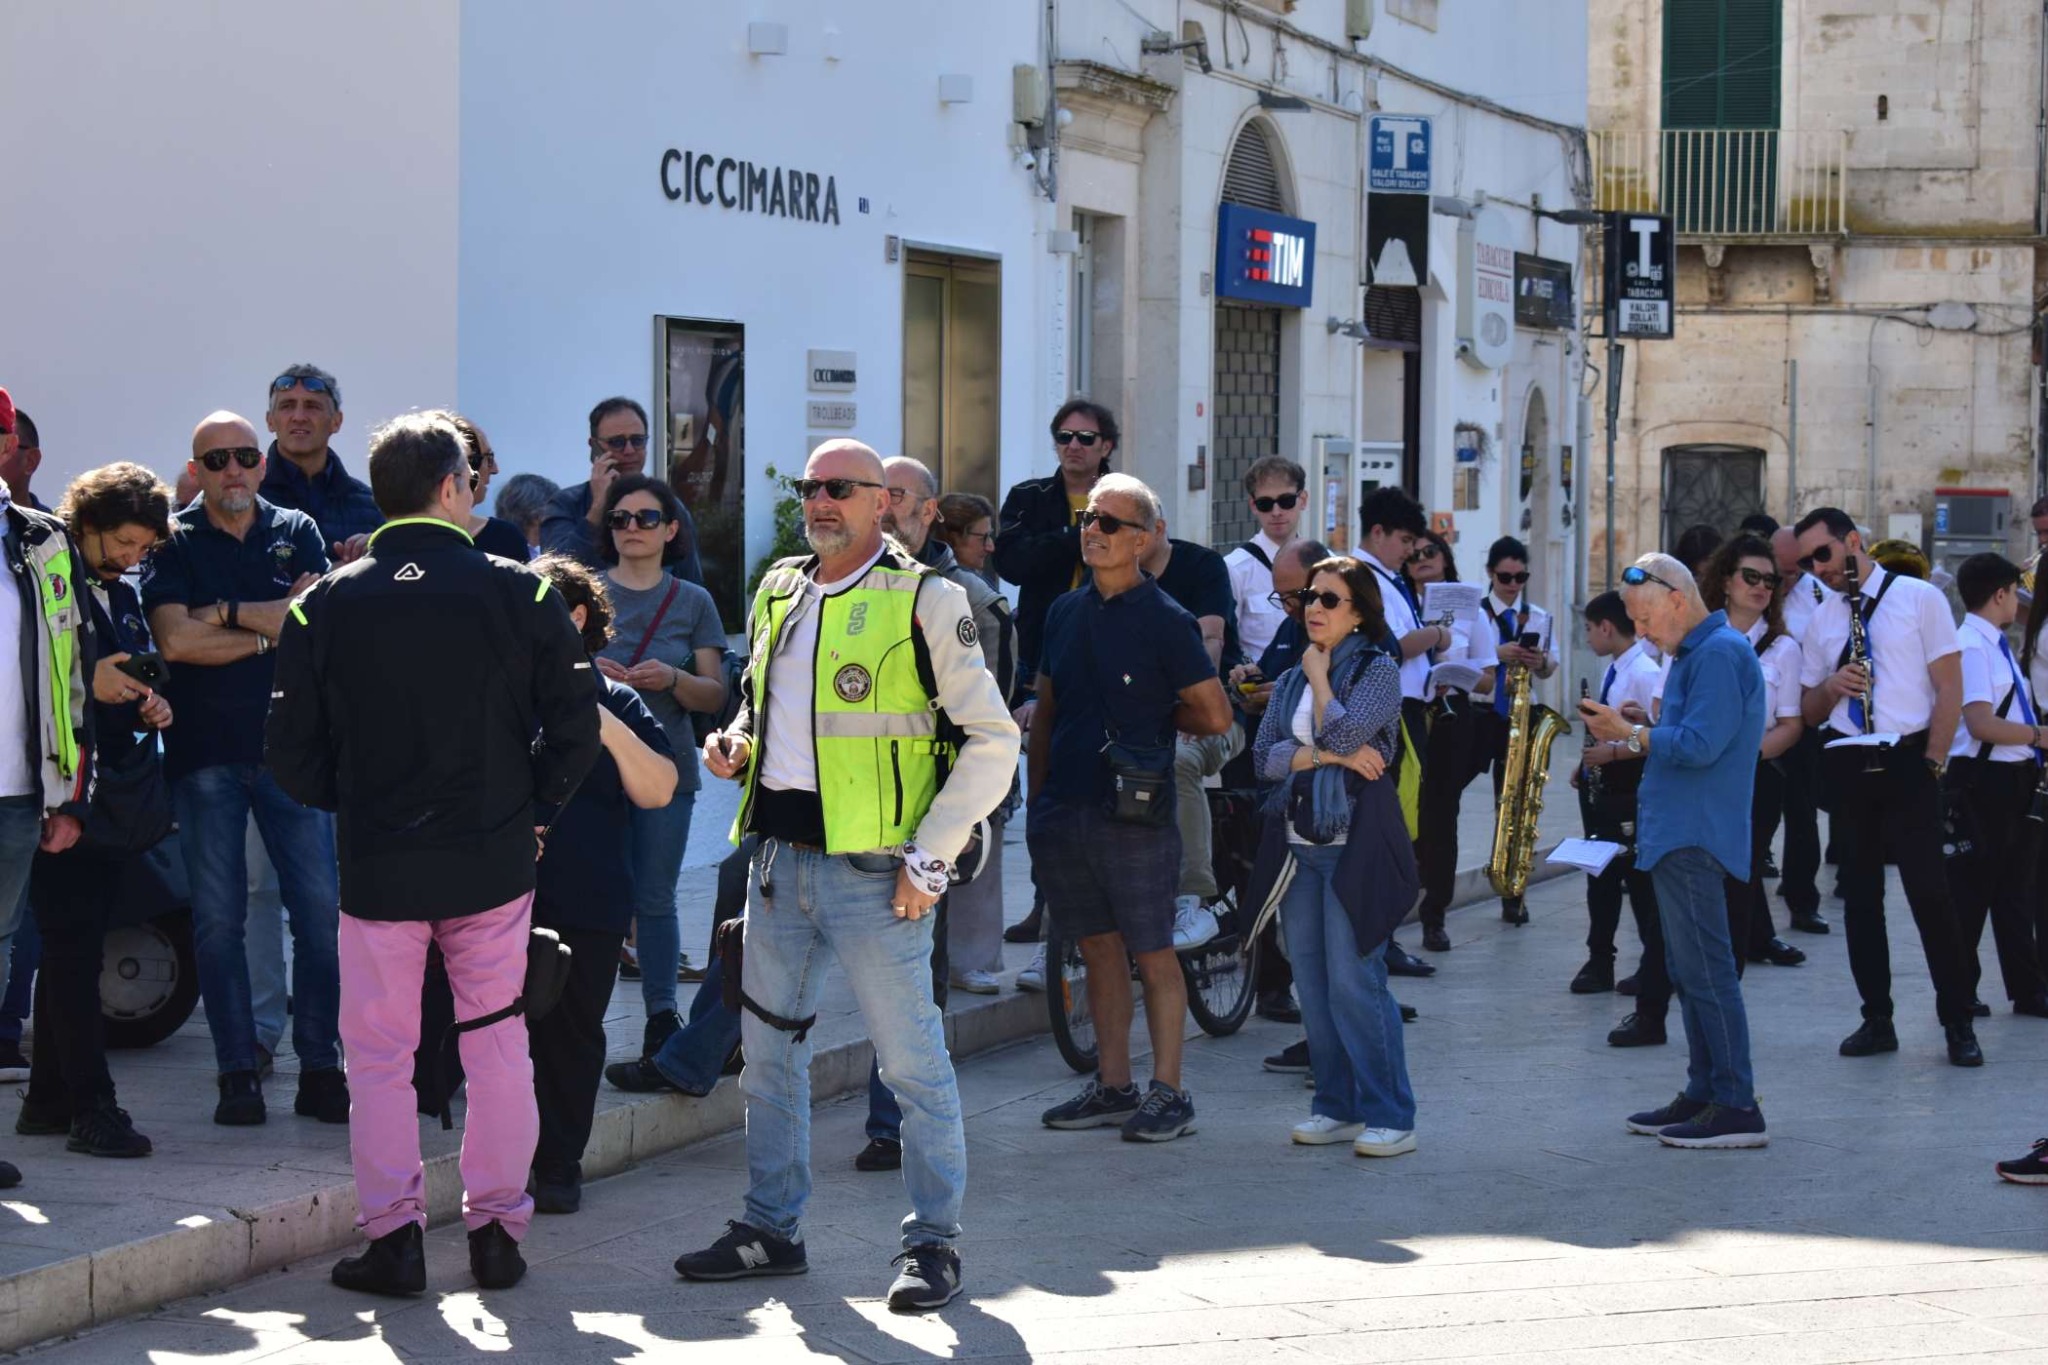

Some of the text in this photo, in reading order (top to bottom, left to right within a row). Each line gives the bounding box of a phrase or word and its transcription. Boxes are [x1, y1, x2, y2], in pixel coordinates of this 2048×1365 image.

[1379, 119, 1422, 170] T
[660, 148, 840, 226] CICCIMARRA
[1272, 232, 1304, 287] TIM
[1630, 218, 1660, 278] T
[1626, 287, 1663, 298] TABACCHI
[1628, 302, 1660, 313] VALORI
[1628, 312, 1660, 322] BOLLATI
